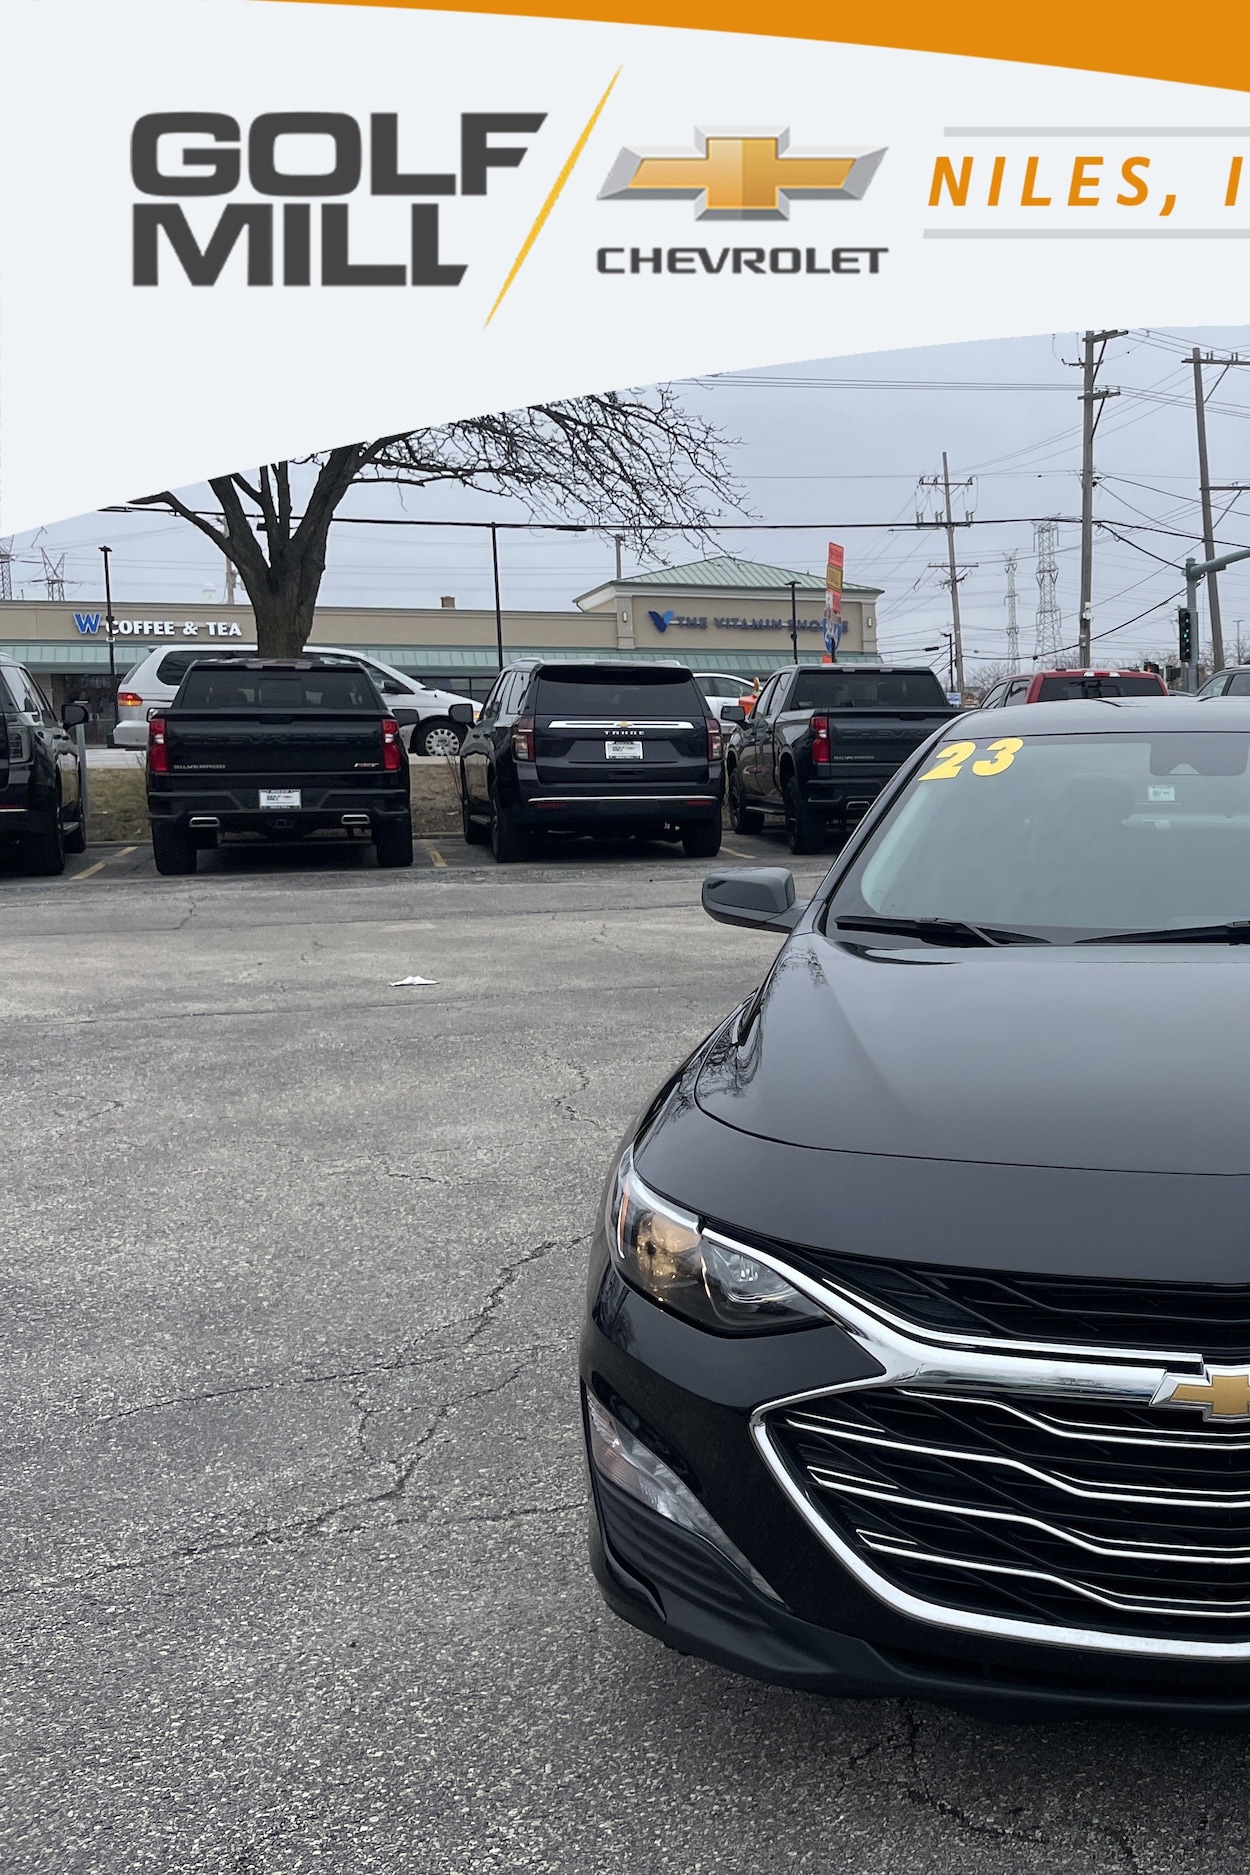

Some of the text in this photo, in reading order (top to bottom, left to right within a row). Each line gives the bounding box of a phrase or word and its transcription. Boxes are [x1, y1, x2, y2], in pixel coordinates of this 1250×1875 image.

[73, 613, 242, 636] W COFFEE & TEA
[676, 616, 849, 633] THE VITAMIN SHOE
[917, 737, 1024, 781] 23
